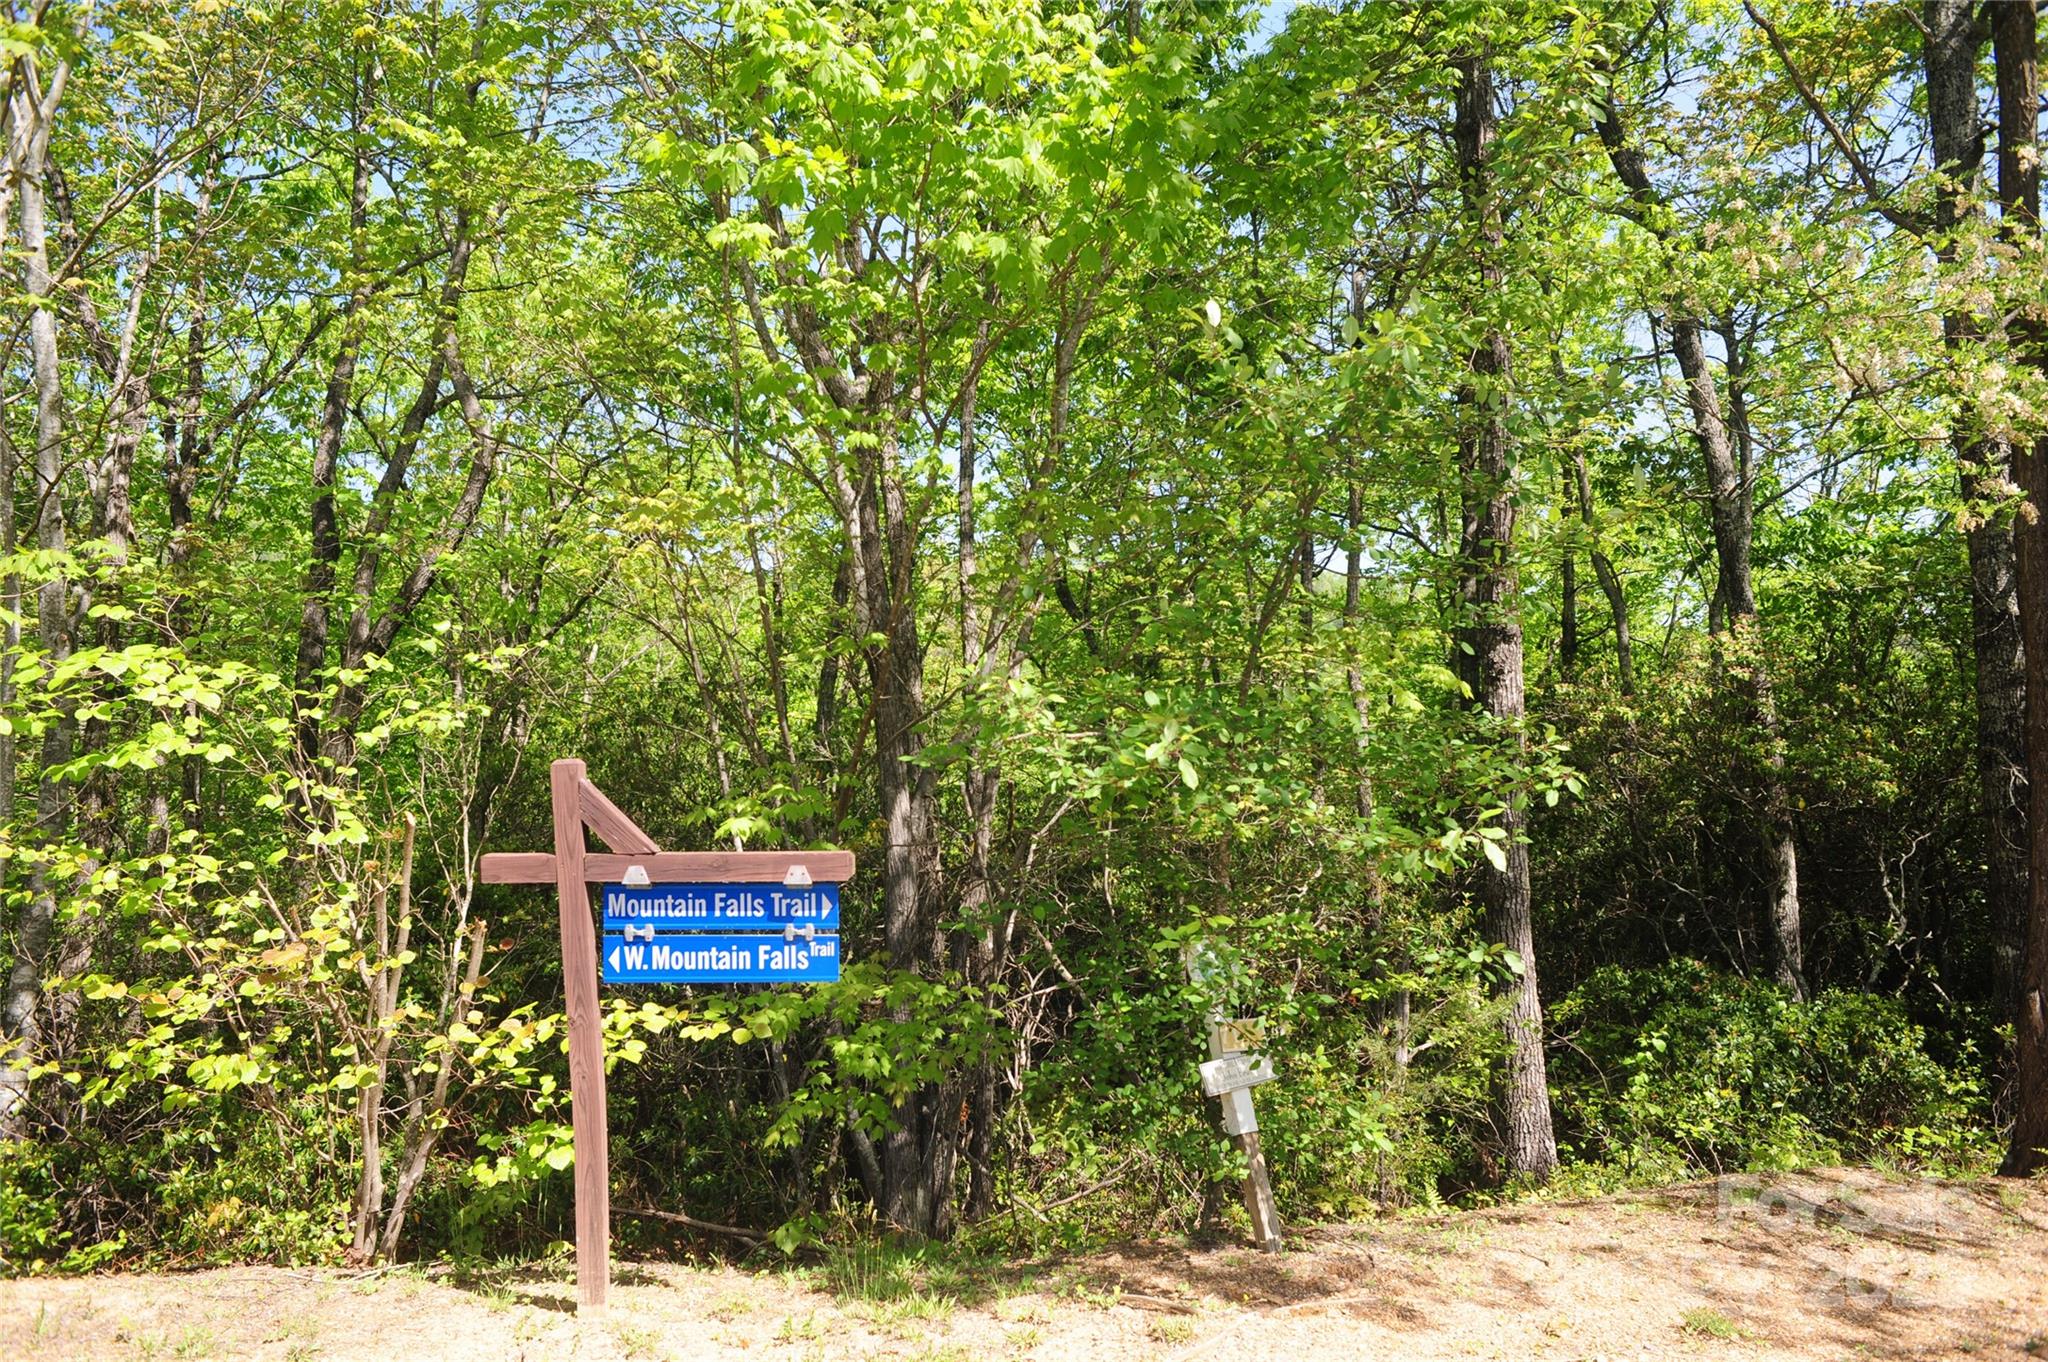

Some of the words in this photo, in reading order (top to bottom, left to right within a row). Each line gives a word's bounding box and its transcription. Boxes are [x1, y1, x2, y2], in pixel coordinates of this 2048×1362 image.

[608, 893, 707, 918] Mountain
[714, 893, 765, 918] Falls
[770, 893, 817, 918] Trail
[758, 945, 809, 970] Falls
[810, 941, 835, 957] Trail
